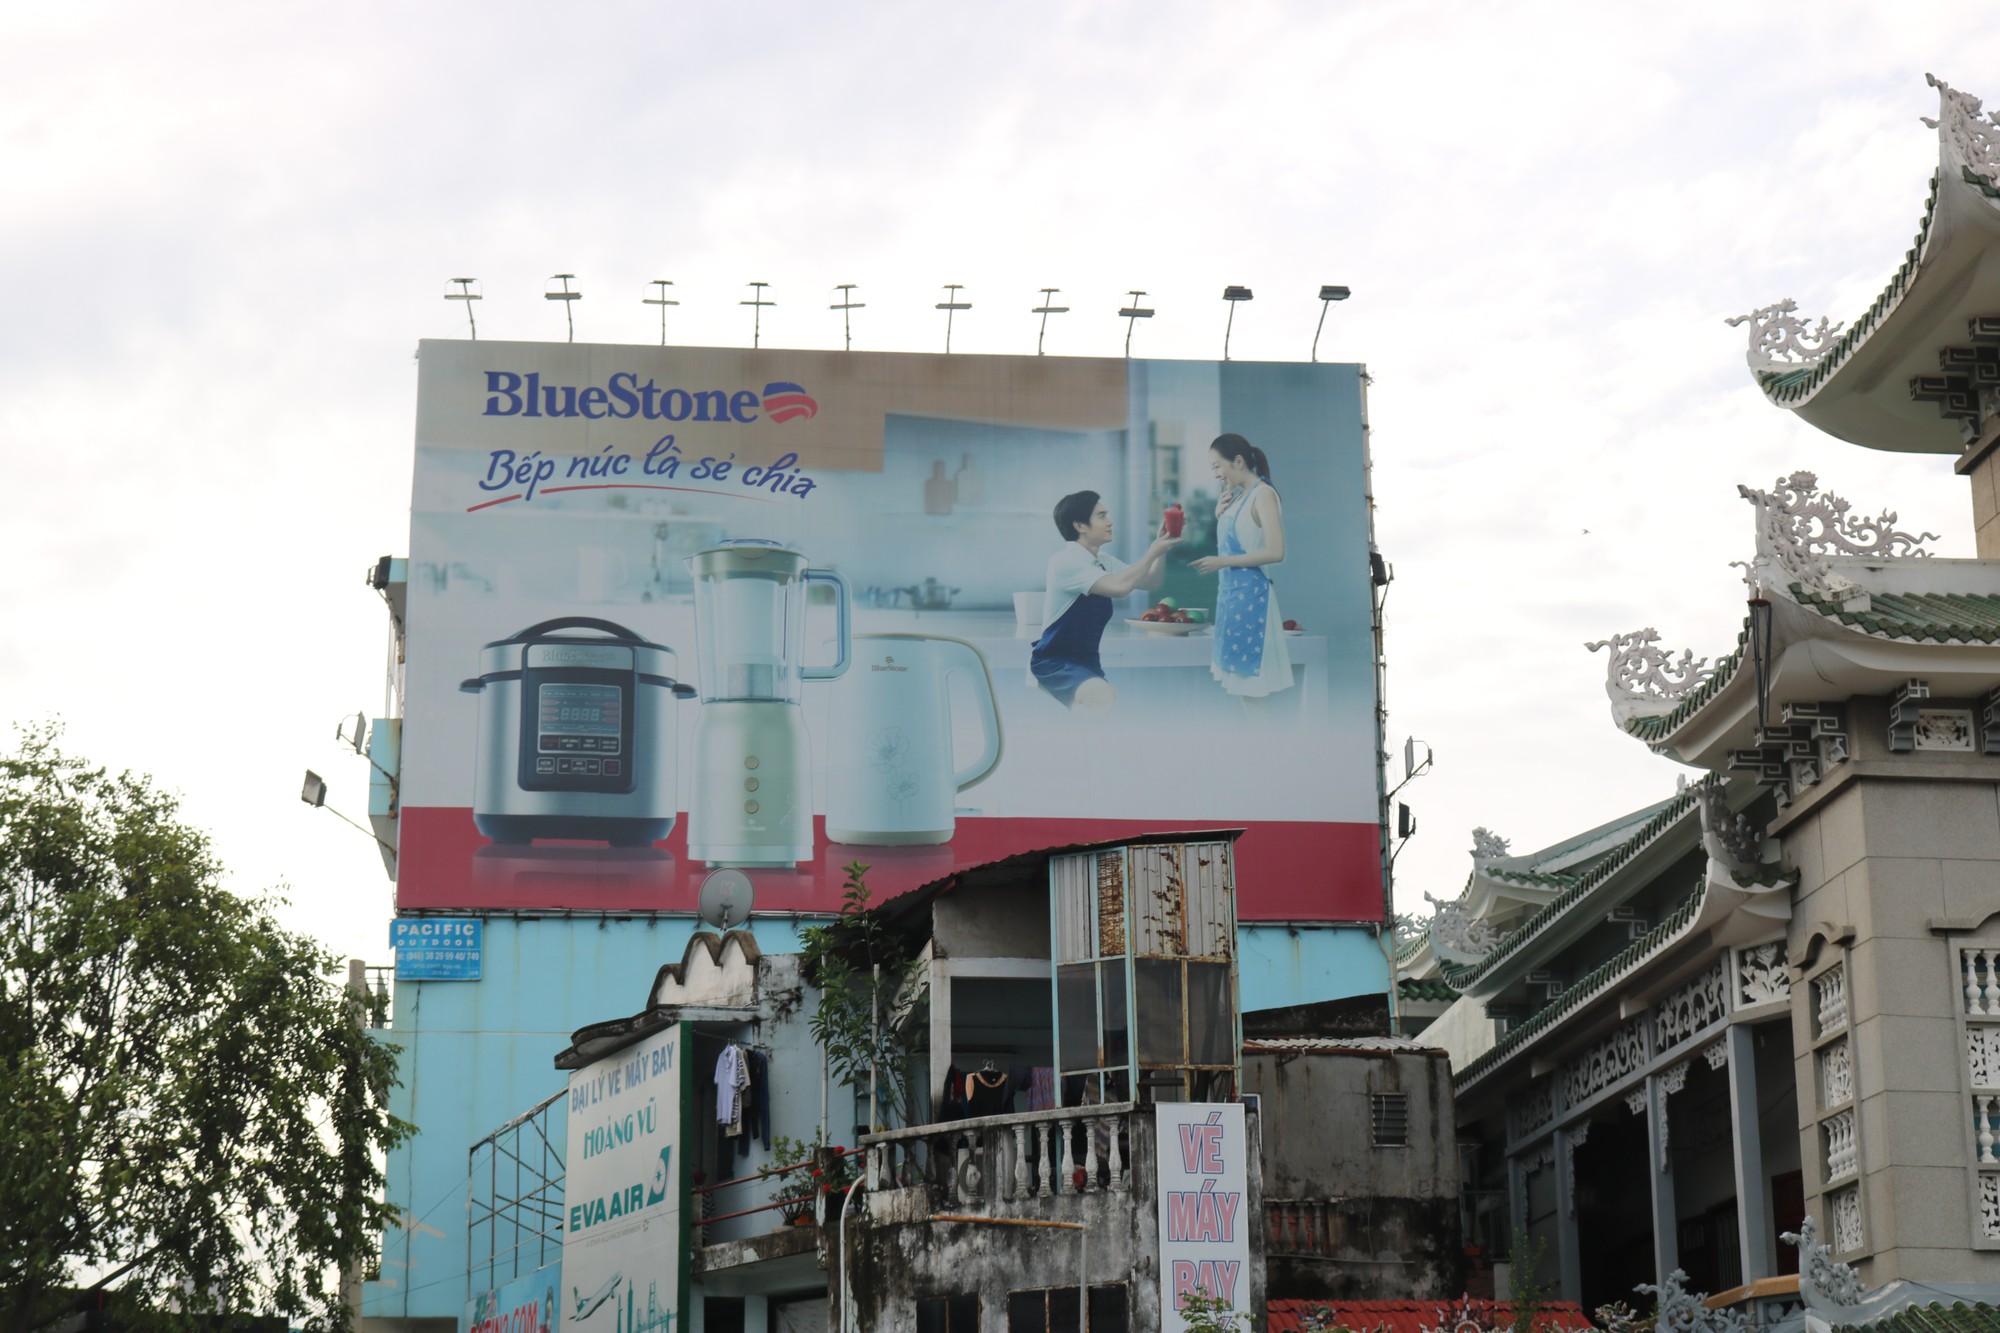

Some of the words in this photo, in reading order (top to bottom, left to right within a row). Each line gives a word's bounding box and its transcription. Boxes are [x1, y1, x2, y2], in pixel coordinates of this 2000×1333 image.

[483, 371, 760, 423] BlueStone
[478, 449, 555, 501] Bếp
[566, 445, 631, 479] núc
[643, 434, 681, 479] là
[690, 453, 735, 481] sẻ
[742, 453, 817, 498] chia
[397, 924, 475, 936] PACIFIC
[397, 939, 475, 947] OUTDOOR
[571, 1082, 589, 1115] ĐẠI
[592, 1069, 605, 1105] LÝ
[608, 1060, 621, 1097] VÉ
[625, 1051, 649, 1091] MÁY
[652, 1041, 674, 1078] BAY
[637, 1096, 657, 1137] VŨ
[1178, 1111, 1224, 1174] VÉ
[1167, 1179, 1240, 1242] MÁY
[1172, 1260, 1240, 1311] BAY
